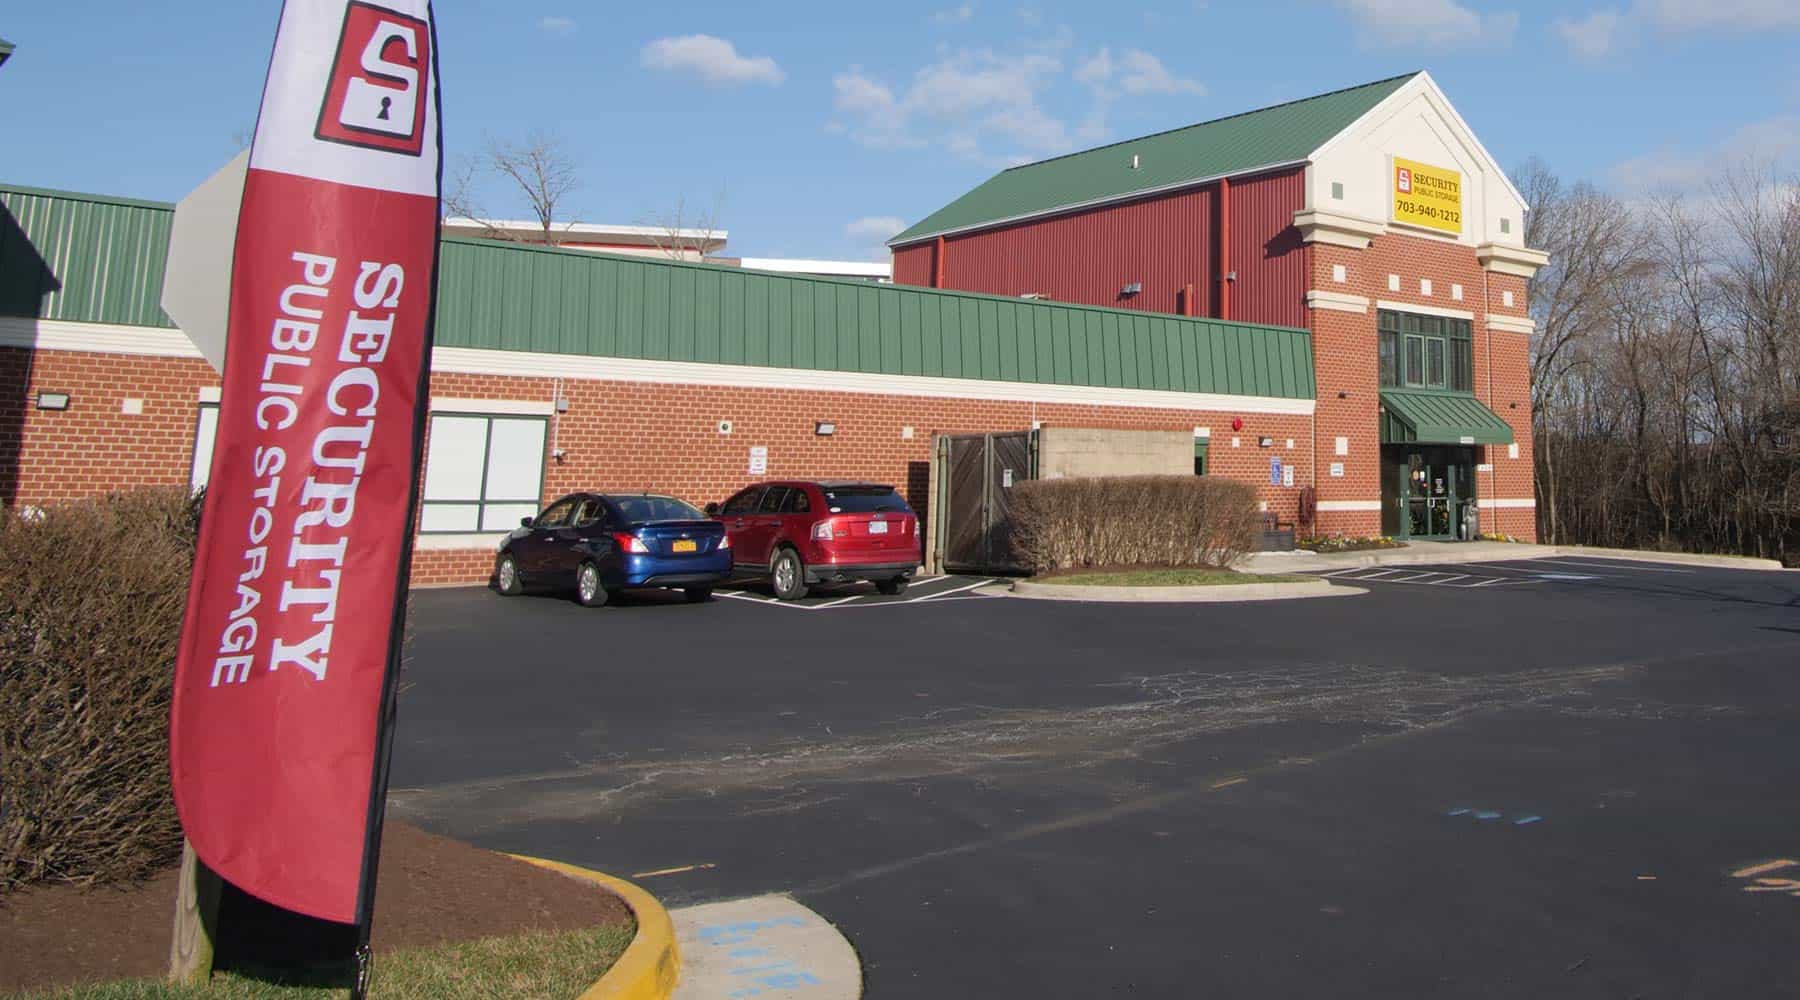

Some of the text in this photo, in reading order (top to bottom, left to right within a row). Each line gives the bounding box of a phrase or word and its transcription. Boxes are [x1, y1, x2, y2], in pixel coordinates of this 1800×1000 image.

[1414, 173, 1458, 193] SECURITY
[1435, 191, 1458, 202] STOR
[1397, 200, 1460, 223] 703-940-1212
[210, 251, 337, 688] PUBLIC STORAGE
[269, 260, 404, 681] SECURITY
